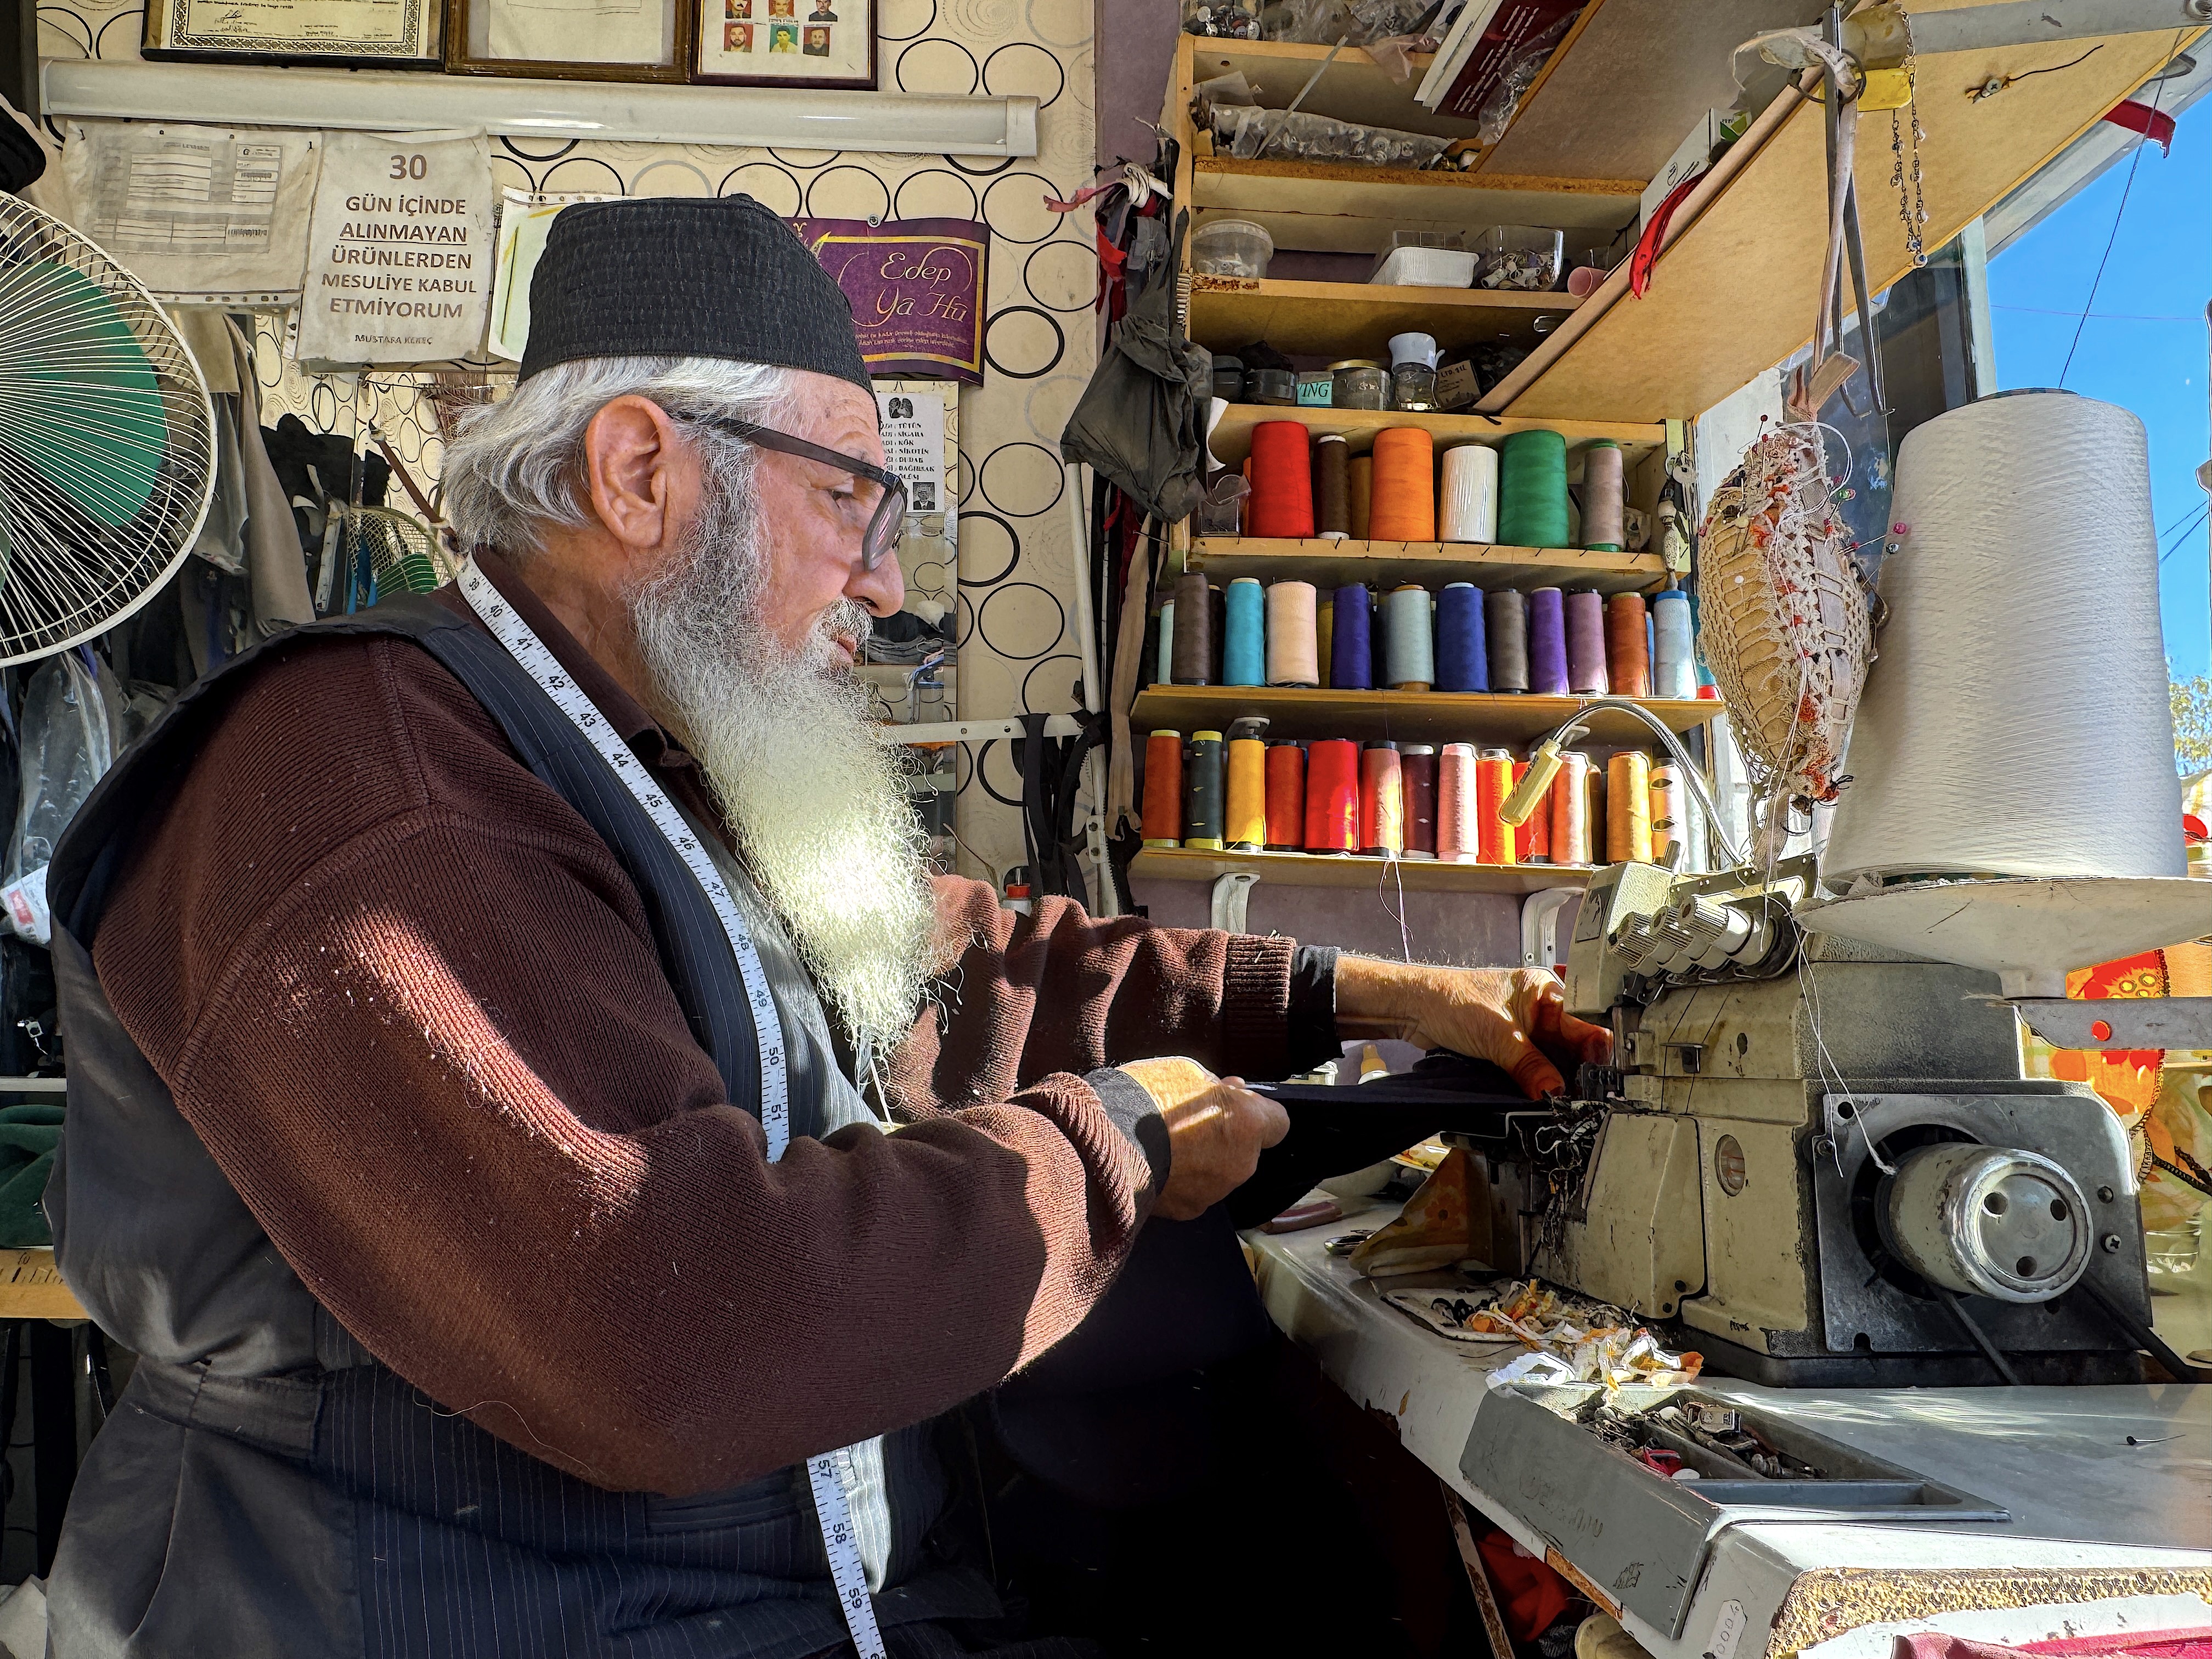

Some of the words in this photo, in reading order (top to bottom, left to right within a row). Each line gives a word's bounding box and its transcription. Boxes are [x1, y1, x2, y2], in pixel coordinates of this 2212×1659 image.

[390, 155, 427, 179] 30
[346, 193, 391, 212] GÜN
[398, 194, 466, 216] İÇİNDE
[340, 223, 466, 243] ALINMAYAN
[332, 245, 471, 268] ÜRÜNLERDEN
[881, 246, 959, 291] Edep
[321, 273, 412, 291] MESULİYE
[419, 279, 477, 293] KABUL
[330, 297, 462, 318] ETMİYORUM
[490, 605, 503, 617] 40
[517, 639, 533, 651] 41
[549, 676, 565, 690] 42
[580, 714, 596, 727] 43
[612, 753, 629, 768] 44
[646, 794, 663, 808] 45
[679, 837, 695, 850] 46
[712, 882, 725, 897] 47
[756, 989, 767, 1007] 49
[769, 1047, 779, 1065] 50
[771, 1104, 782, 1121] 51
[818, 1459, 833, 1479] 57
[833, 1523, 847, 1544] 58
[848, 1588, 862, 1609] 59
